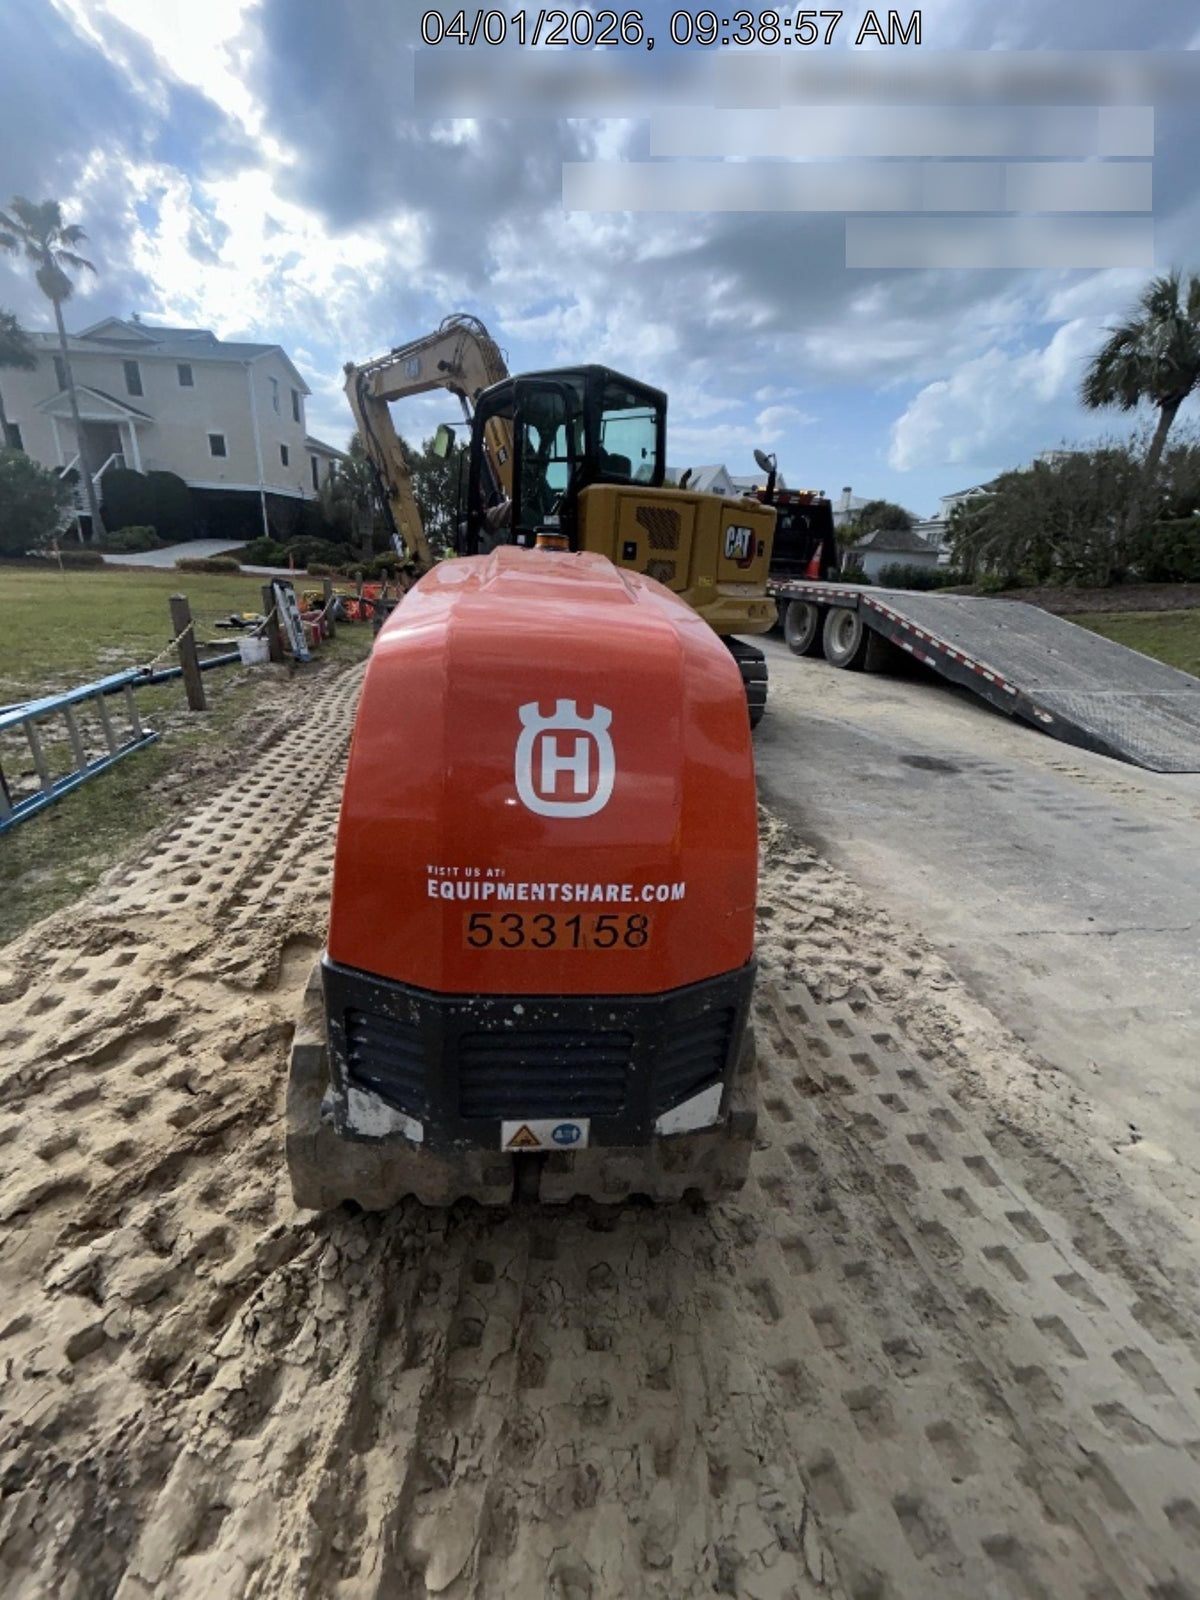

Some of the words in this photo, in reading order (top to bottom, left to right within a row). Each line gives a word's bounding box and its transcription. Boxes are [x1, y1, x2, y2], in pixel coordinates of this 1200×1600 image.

[725, 526, 752, 558] CAT
[541, 736, 590, 794] H
[465, 867, 481, 877] US
[427, 879, 686, 902] EQUIPMENTSHARE.COM
[467, 913, 649, 949] 533158
